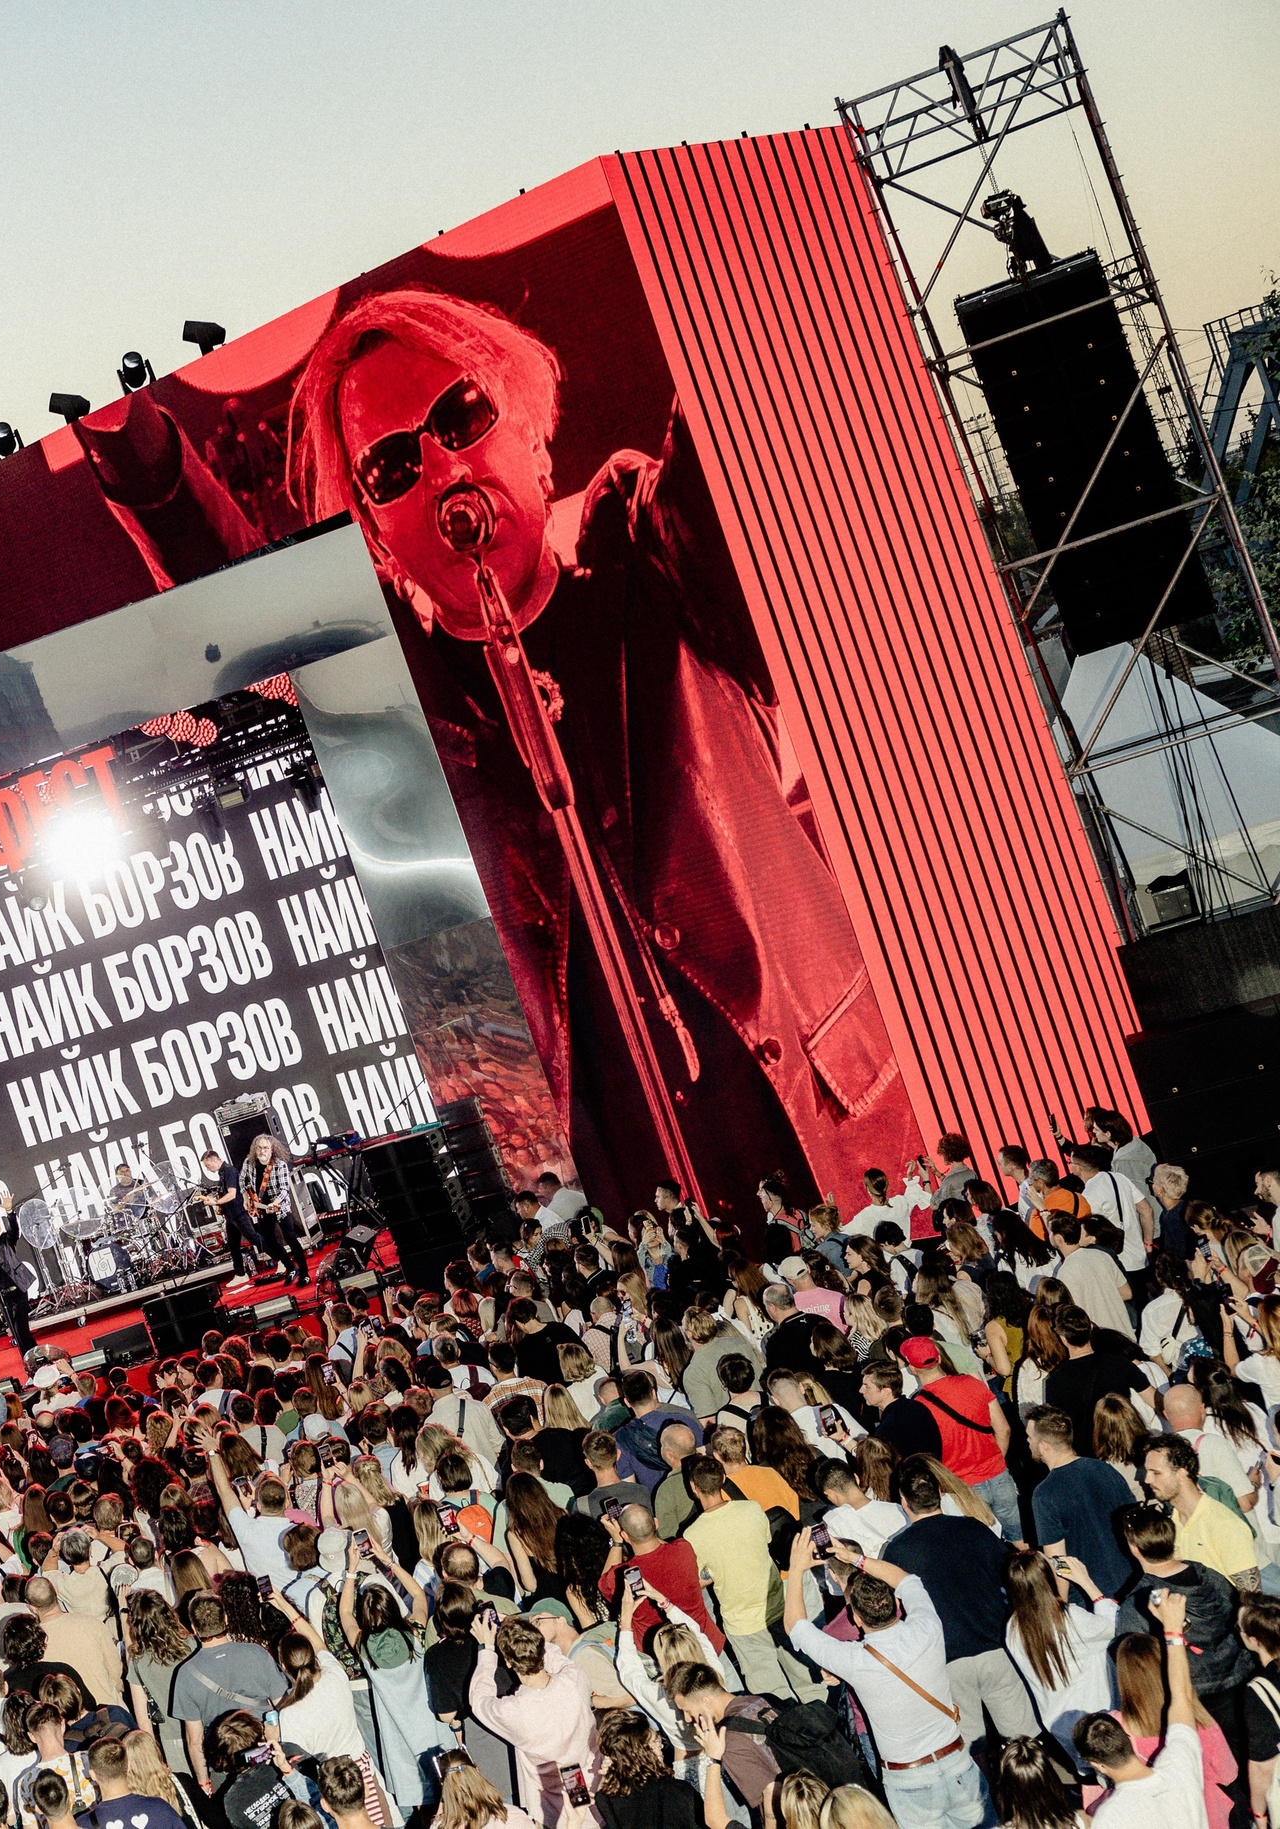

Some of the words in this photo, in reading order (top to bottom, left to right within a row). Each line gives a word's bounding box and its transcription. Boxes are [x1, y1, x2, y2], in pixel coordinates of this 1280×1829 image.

[79, 829, 245, 940] БОРЗОВ
[102, 910, 273, 1023] БОРЗОВ
[6, 1044, 142, 1148] НАЙК
[131, 997, 303, 1109] БОРЗОВ
[33, 1126, 169, 1230] НАЙК
[159, 1083, 331, 1192] БООВ
